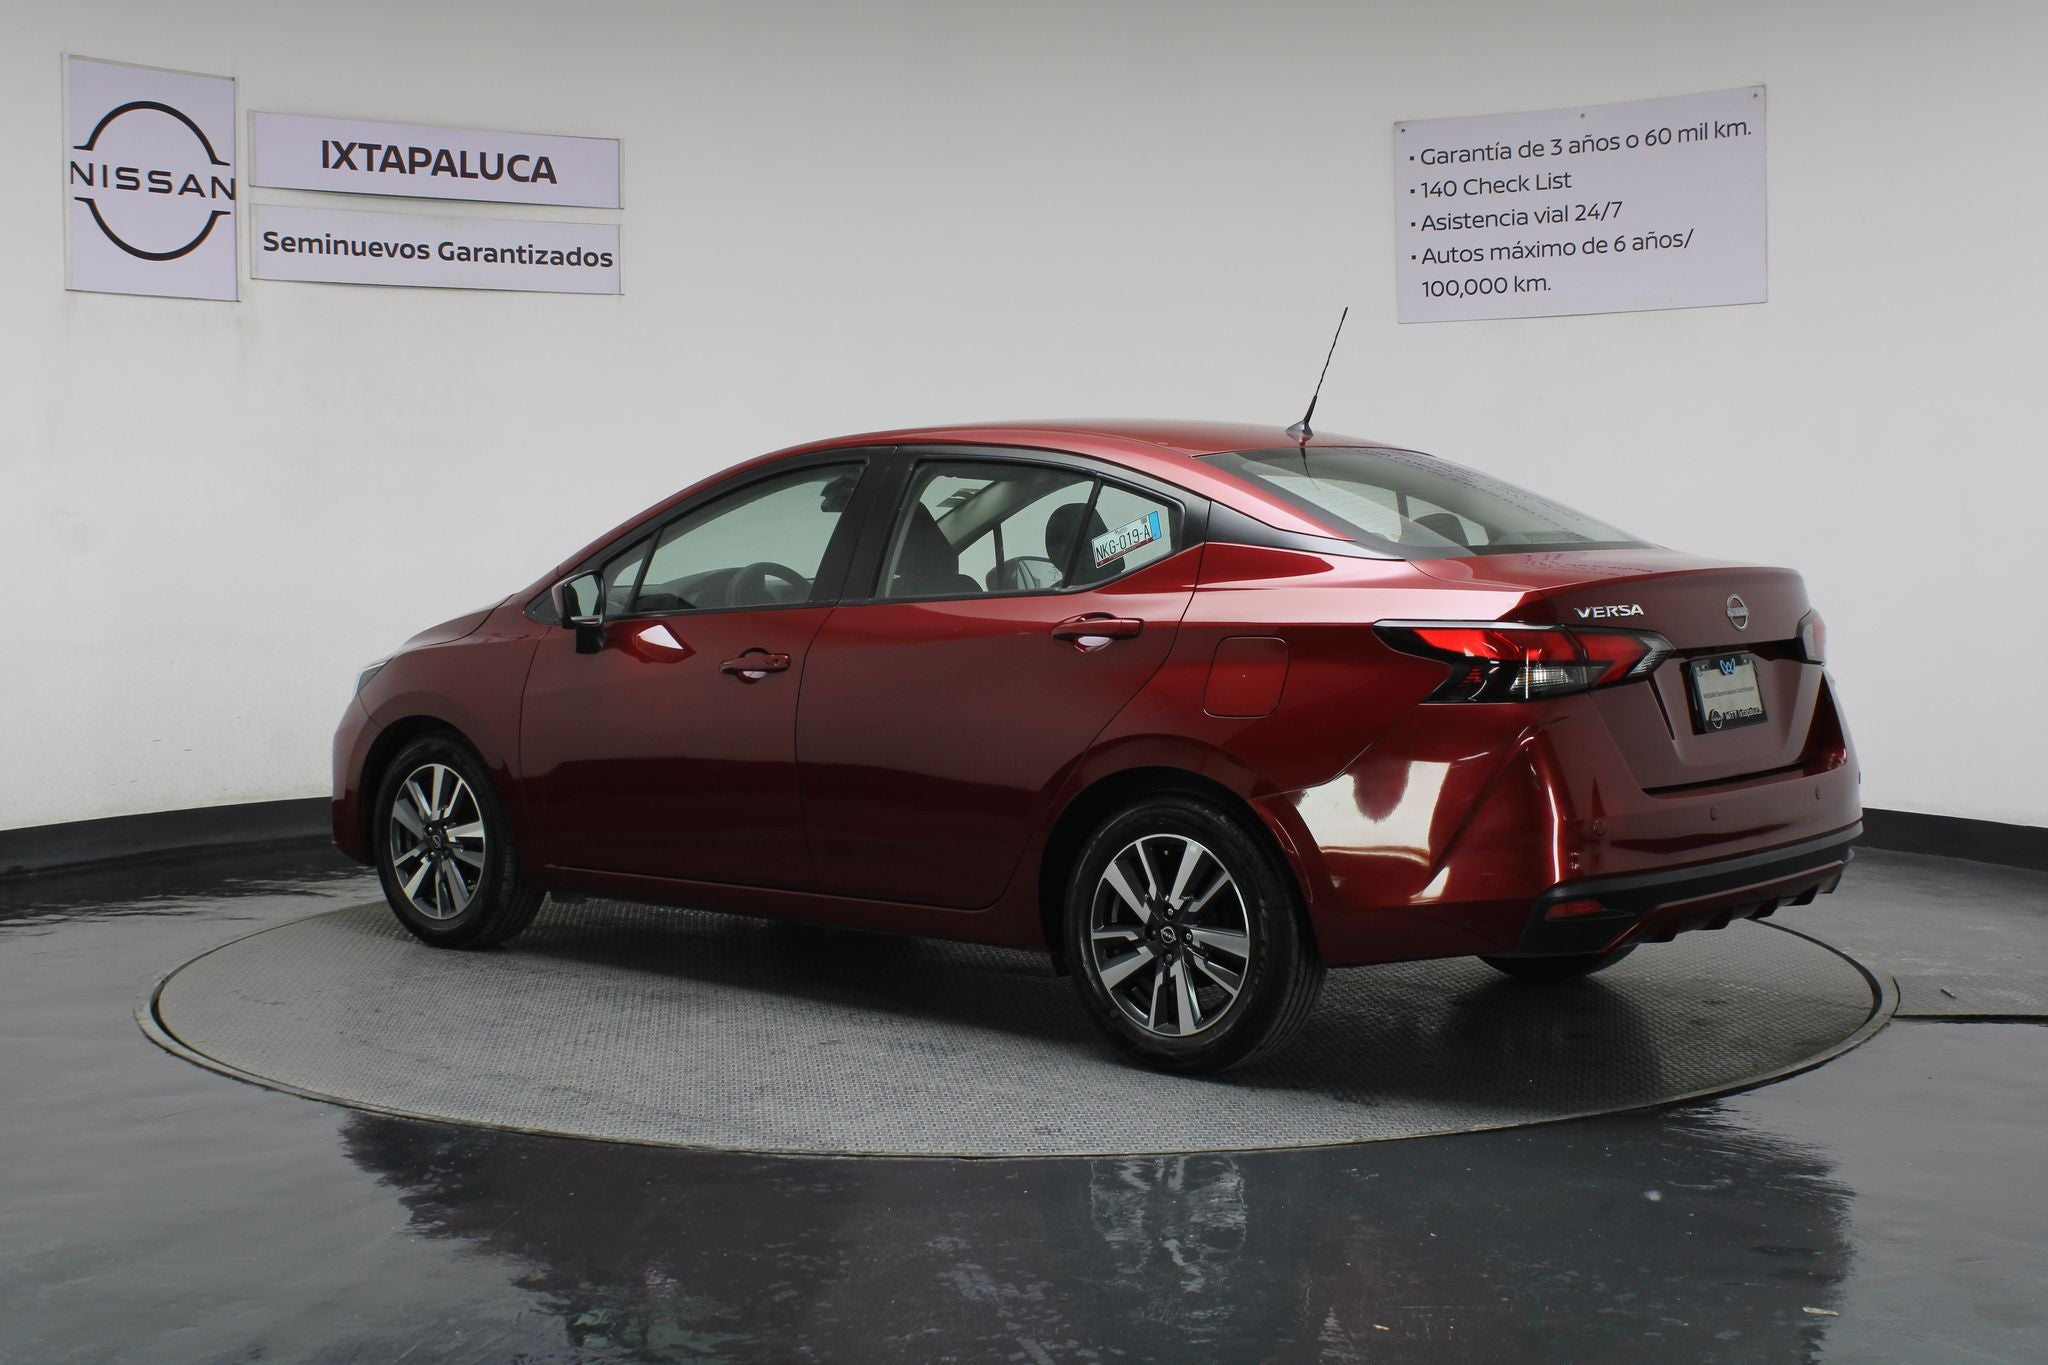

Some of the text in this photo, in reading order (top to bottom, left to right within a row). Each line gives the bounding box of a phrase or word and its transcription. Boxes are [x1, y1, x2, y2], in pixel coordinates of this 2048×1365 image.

[1420, 120, 1752, 166] Garantía de 3 años o 60 mil km.
[70, 154, 237, 202] NISSAN
[321, 139, 558, 185] IXTAPALUCA
[1421, 171, 1573, 199] 140 Check List
[1420, 201, 1623, 232] Asistencia vial 24/7
[263, 231, 614, 268] Seminuevos Garantizados
[1421, 228, 1694, 265] Autos máximo de 6 años/
[1422, 275, 1552, 299] 100,000 km.
[1096, 524, 1150, 561] NKG-019-A
[1574, 604, 1645, 619] VERSA
